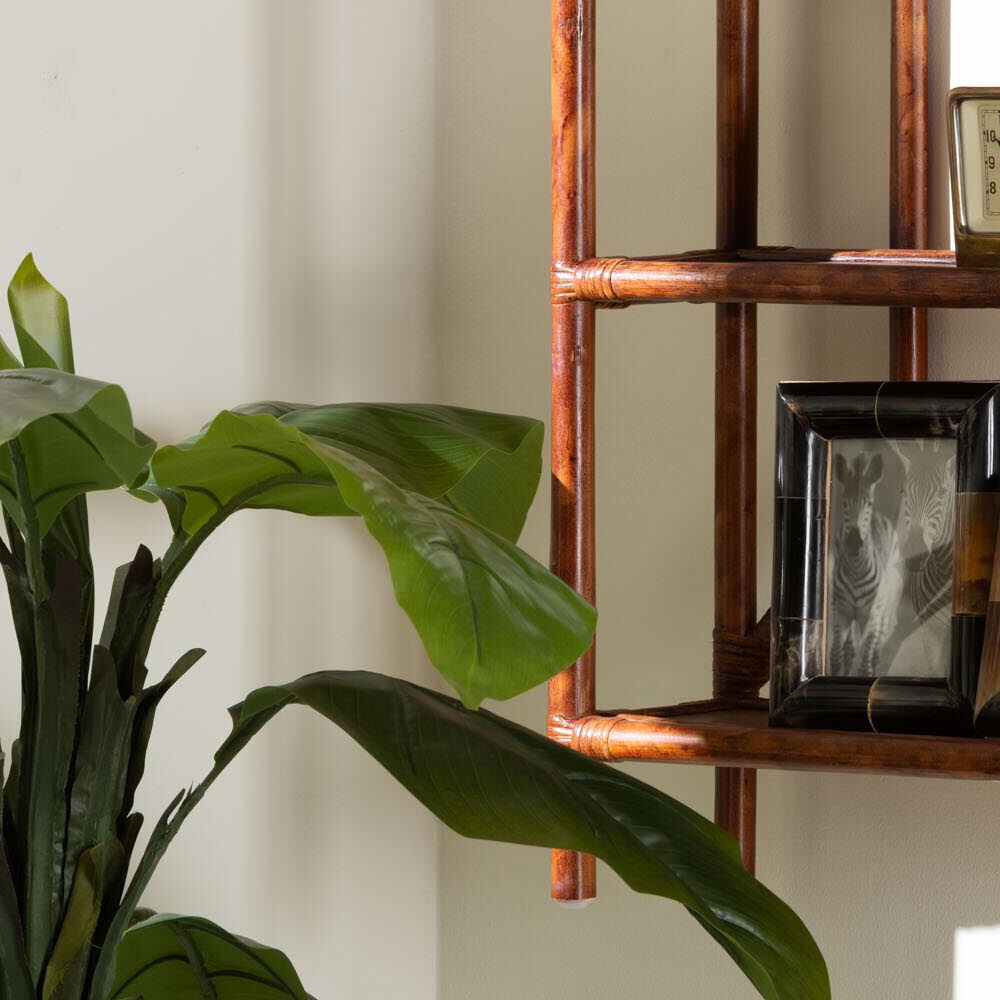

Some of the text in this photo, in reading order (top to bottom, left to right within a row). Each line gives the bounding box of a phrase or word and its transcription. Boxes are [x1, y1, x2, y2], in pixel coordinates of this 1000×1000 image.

[986, 129, 996, 143] 10
[988, 156, 996, 169] 9
[989, 181, 997, 194] 8
